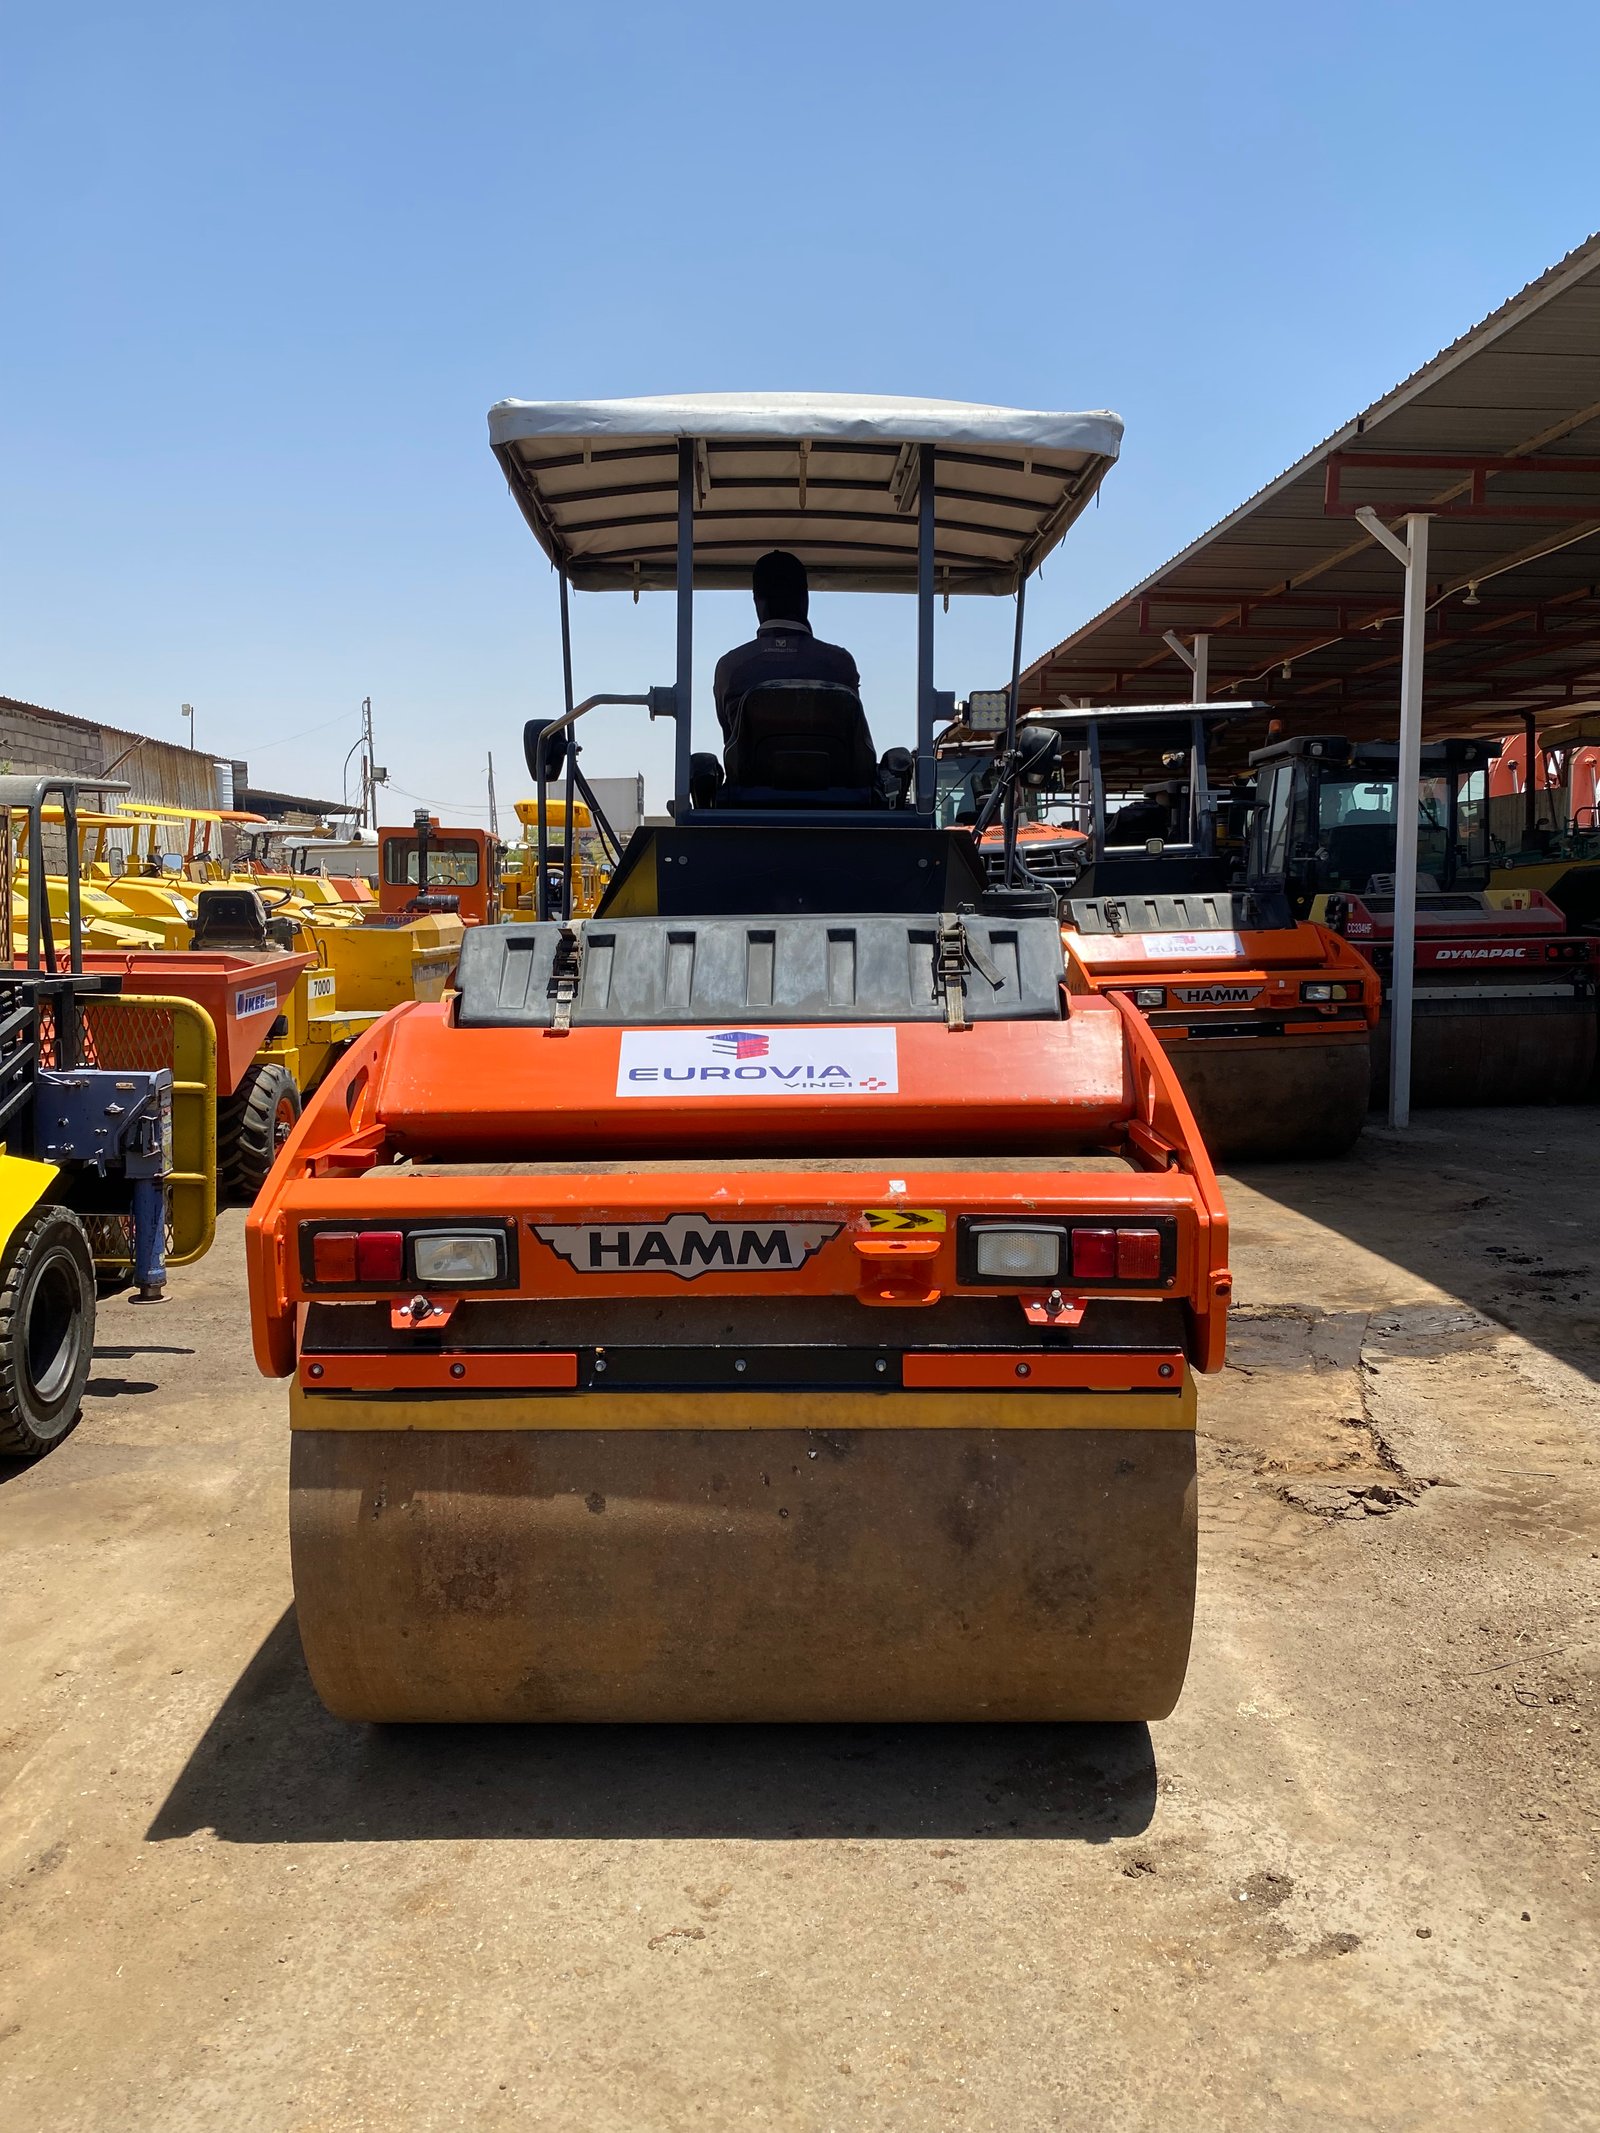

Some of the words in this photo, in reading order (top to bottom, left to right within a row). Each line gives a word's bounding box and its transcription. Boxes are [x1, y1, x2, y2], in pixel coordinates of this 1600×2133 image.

[1436, 948, 1526, 960] DYNAPAC
[314, 979, 331, 996] 7000
[1187, 989, 1249, 1002] HAMM
[629, 1064, 852, 1081] EUROVIA
[589, 1229, 793, 1267] HAMM
